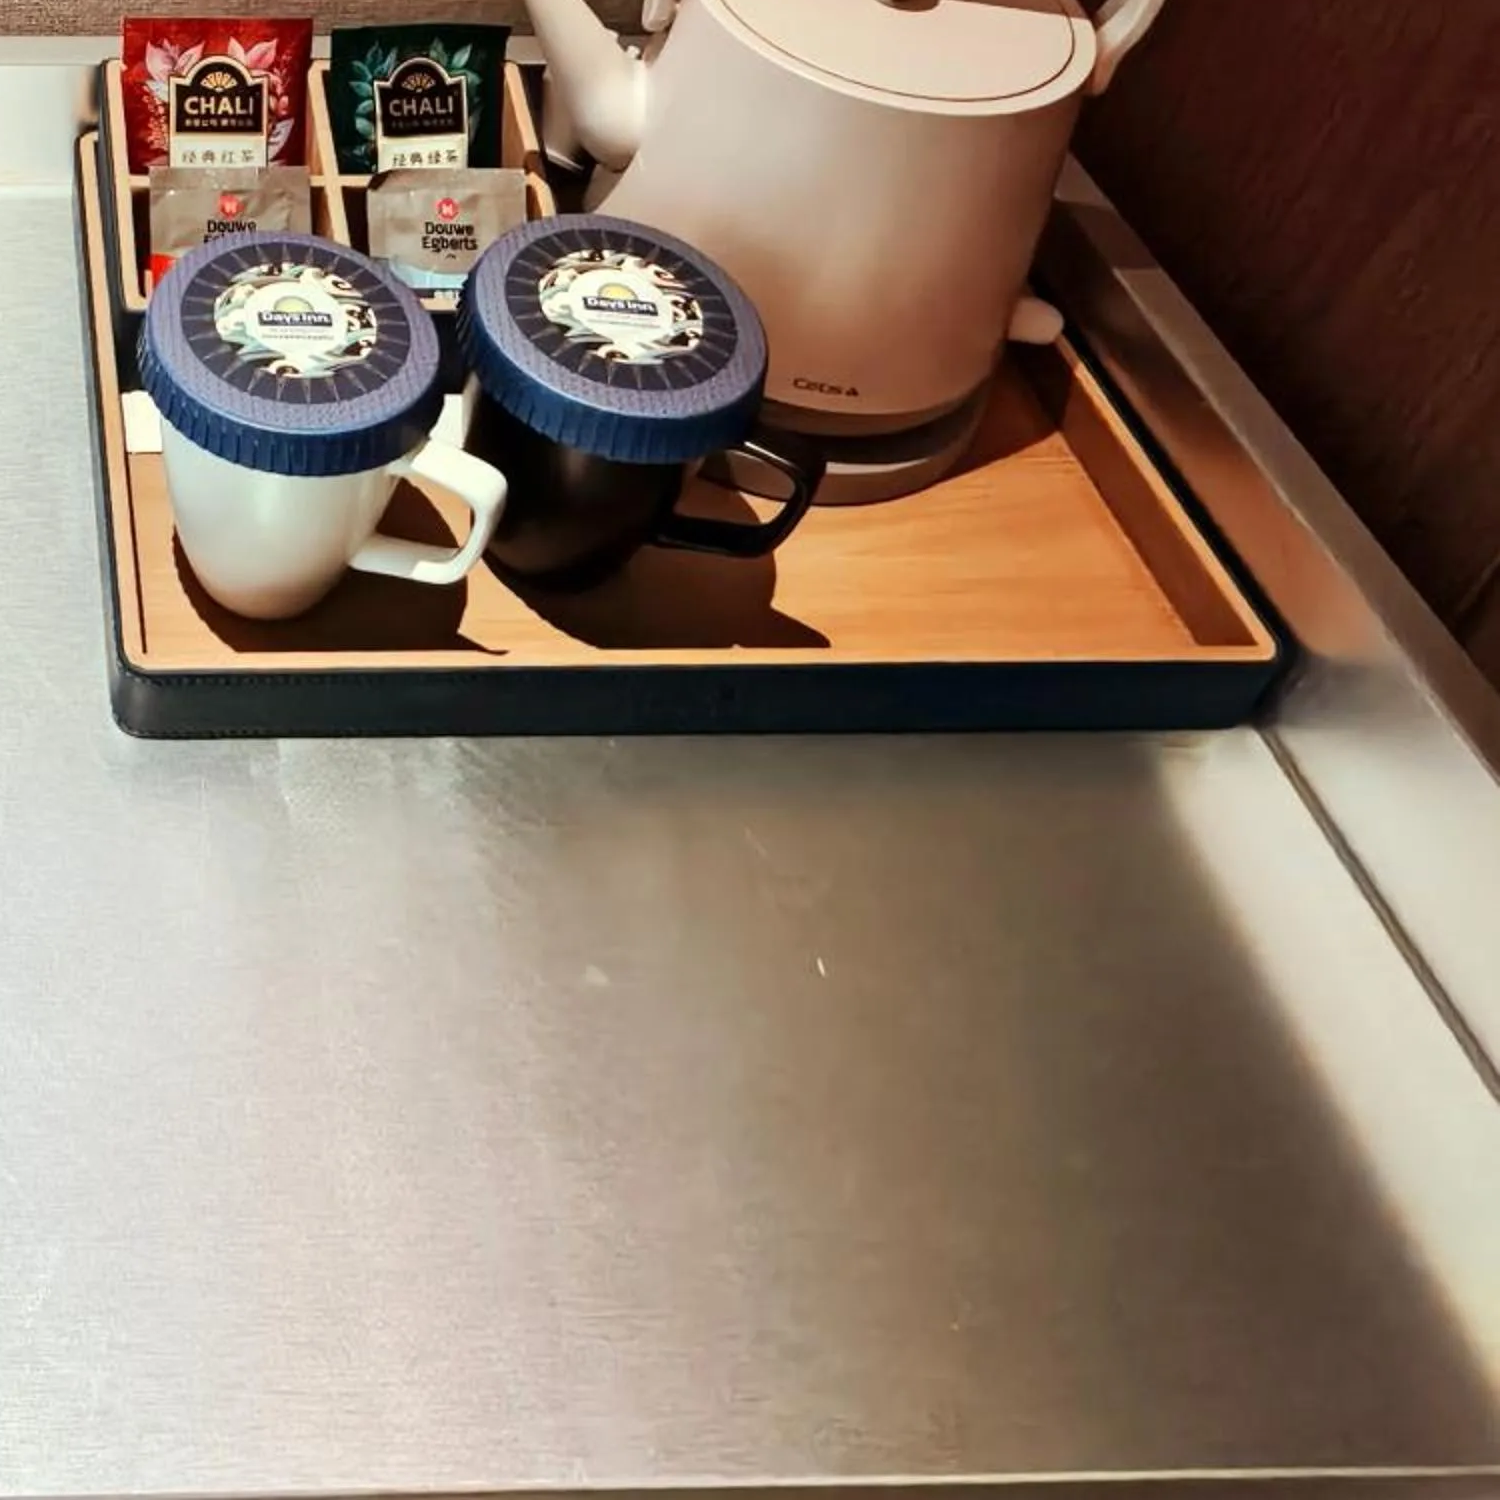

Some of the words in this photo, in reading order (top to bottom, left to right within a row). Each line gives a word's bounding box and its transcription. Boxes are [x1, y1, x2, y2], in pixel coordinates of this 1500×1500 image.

[184, 96, 254, 115] CHALI
[389, 95, 453, 116] CHALI
[207, 220, 257, 233] Douwe
[425, 221, 475, 236] Douwe
[421, 235, 478, 253] Egberts
[262, 311, 301, 325] Days
[302, 312, 329, 323] Inn
